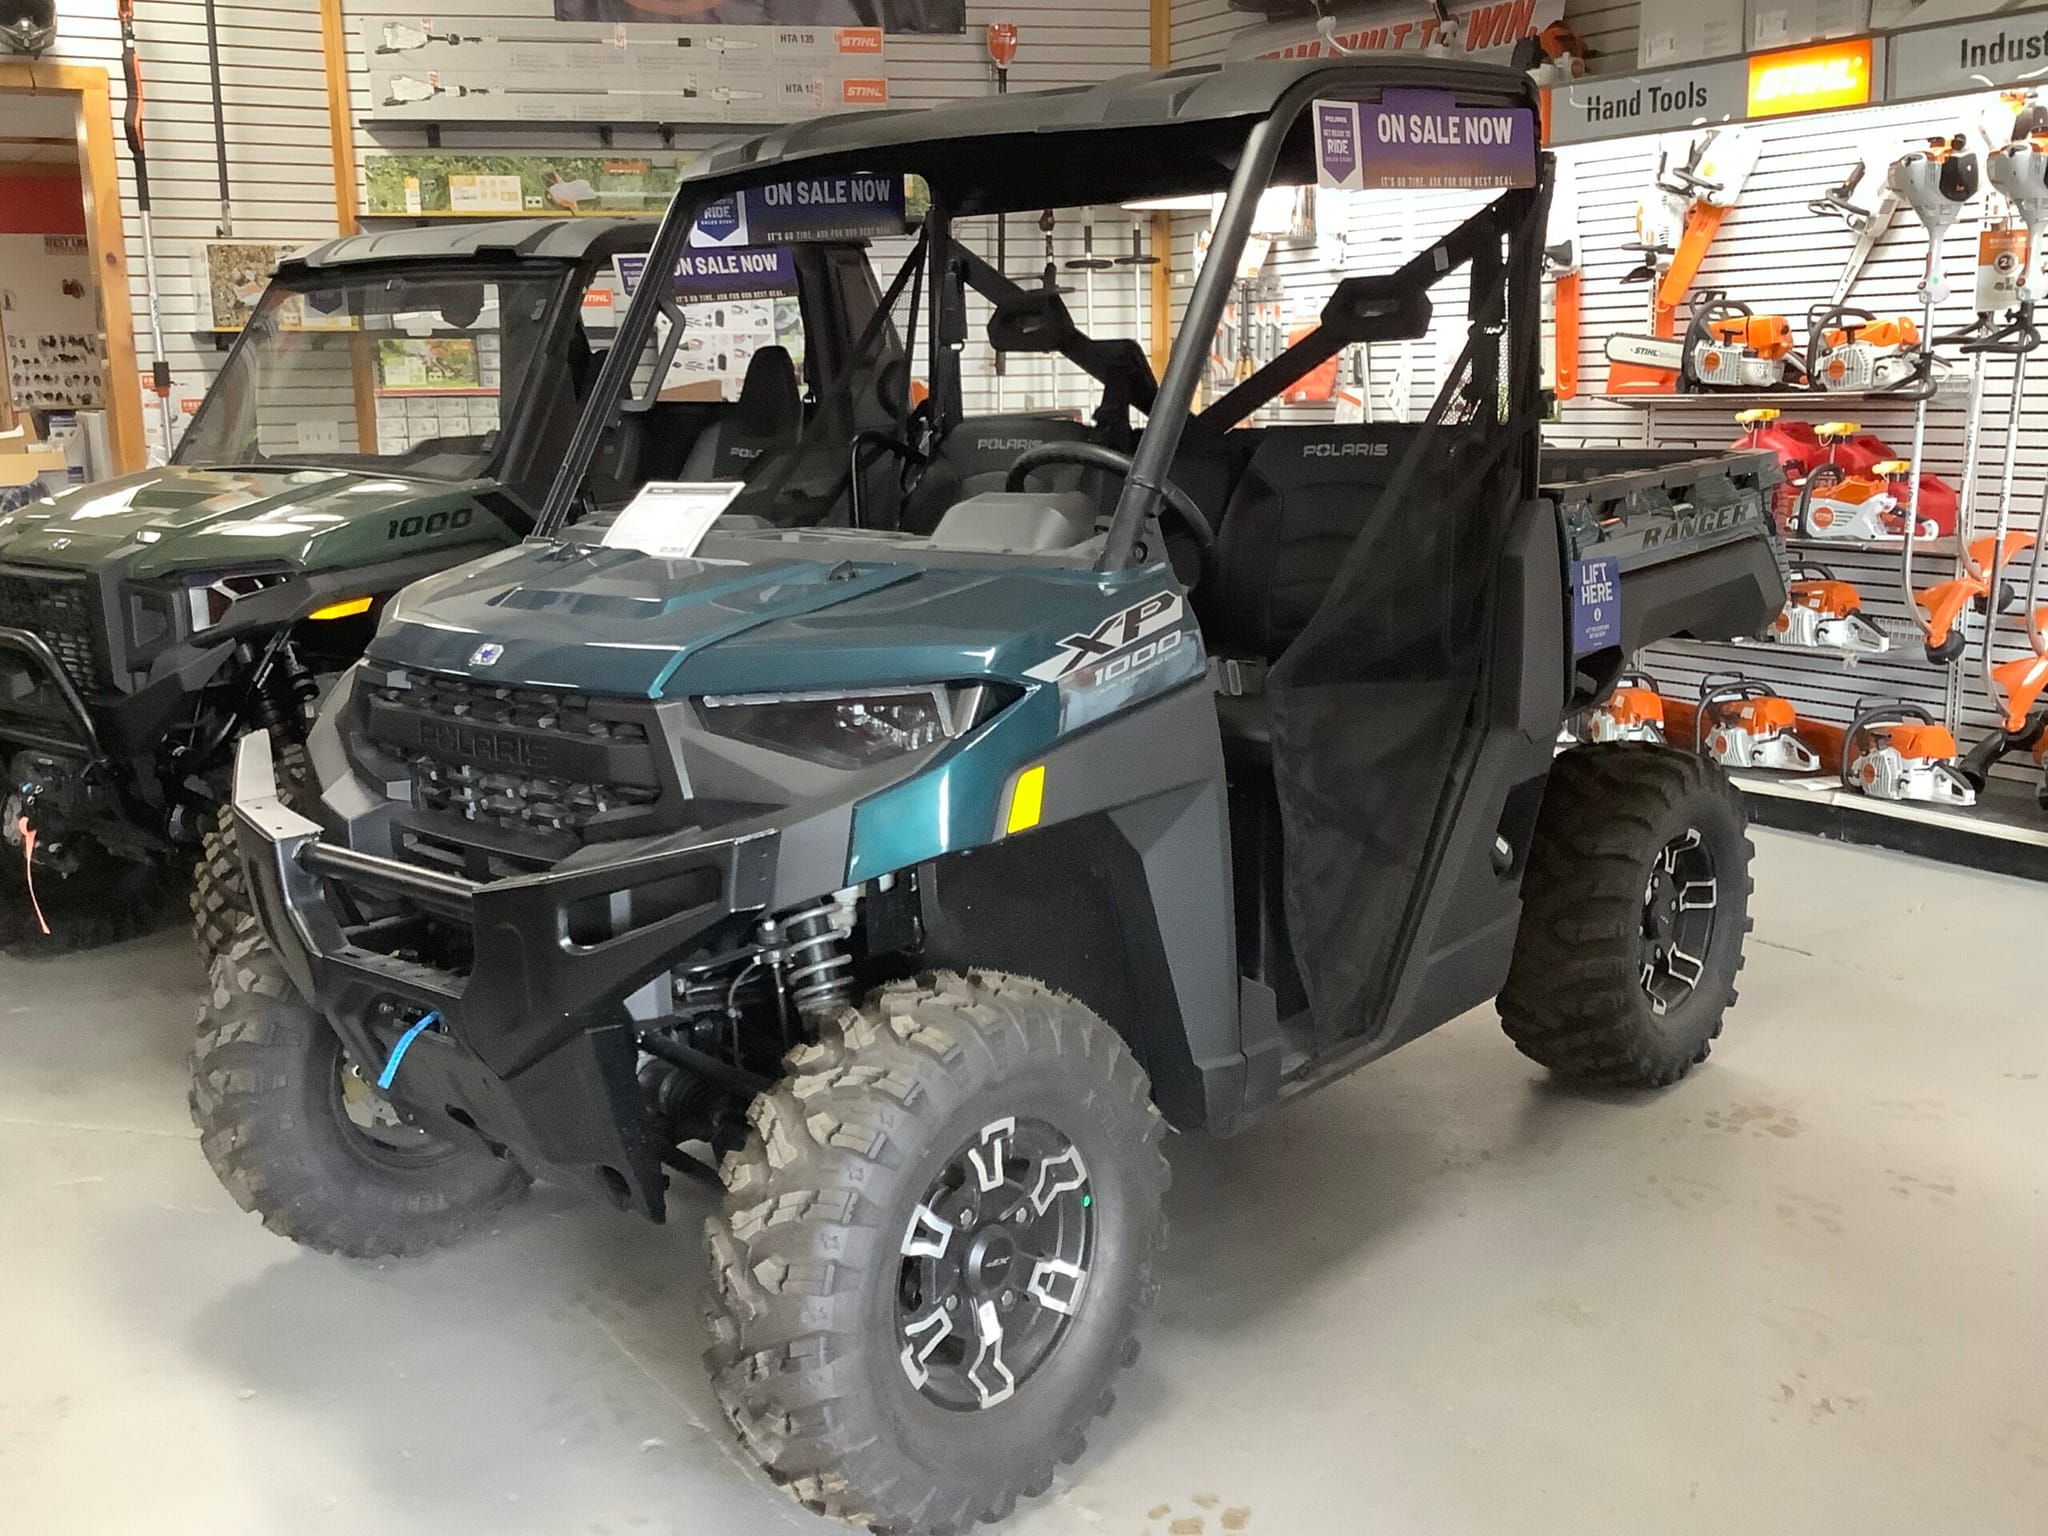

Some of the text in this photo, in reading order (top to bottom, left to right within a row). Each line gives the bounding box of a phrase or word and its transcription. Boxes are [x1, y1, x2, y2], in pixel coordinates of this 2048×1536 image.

[1466, 0, 1538, 52] WIN.
[780, 34, 815, 44] HTA 135
[841, 36, 878, 48] STIHL
[785, 84, 803, 93] HTA
[847, 86, 882, 97] STIHL
[1586, 81, 1708, 122] Hand Tools
[1377, 113, 1513, 145] ON SALE NOW
[1327, 138, 1349, 155] RIDE
[764, 178, 890, 206] ON SALE NOW
[1381, 176, 1394, 187] IT'S
[1474, 175, 1492, 187] BEST
[1495, 175, 1516, 186] DEAL.
[703, 205, 731, 219] RIDE
[767, 232, 782, 241] IT'S
[696, 255, 739, 276] SALE
[741, 253, 778, 273] NOW
[1634, 346, 1659, 357] STIHL
[977, 438, 1043, 450] POLARIS
[1303, 442, 1389, 458] POLARIS
[387, 507, 474, 540] 1000
[1641, 502, 1750, 551] RANGER
[1581, 562, 1608, 585] LIFT
[1580, 581, 1614, 606] HERE
[1052, 588, 1184, 682] XP
[1093, 628, 1182, 687] 1000
[418, 722, 549, 768] POLARIS
